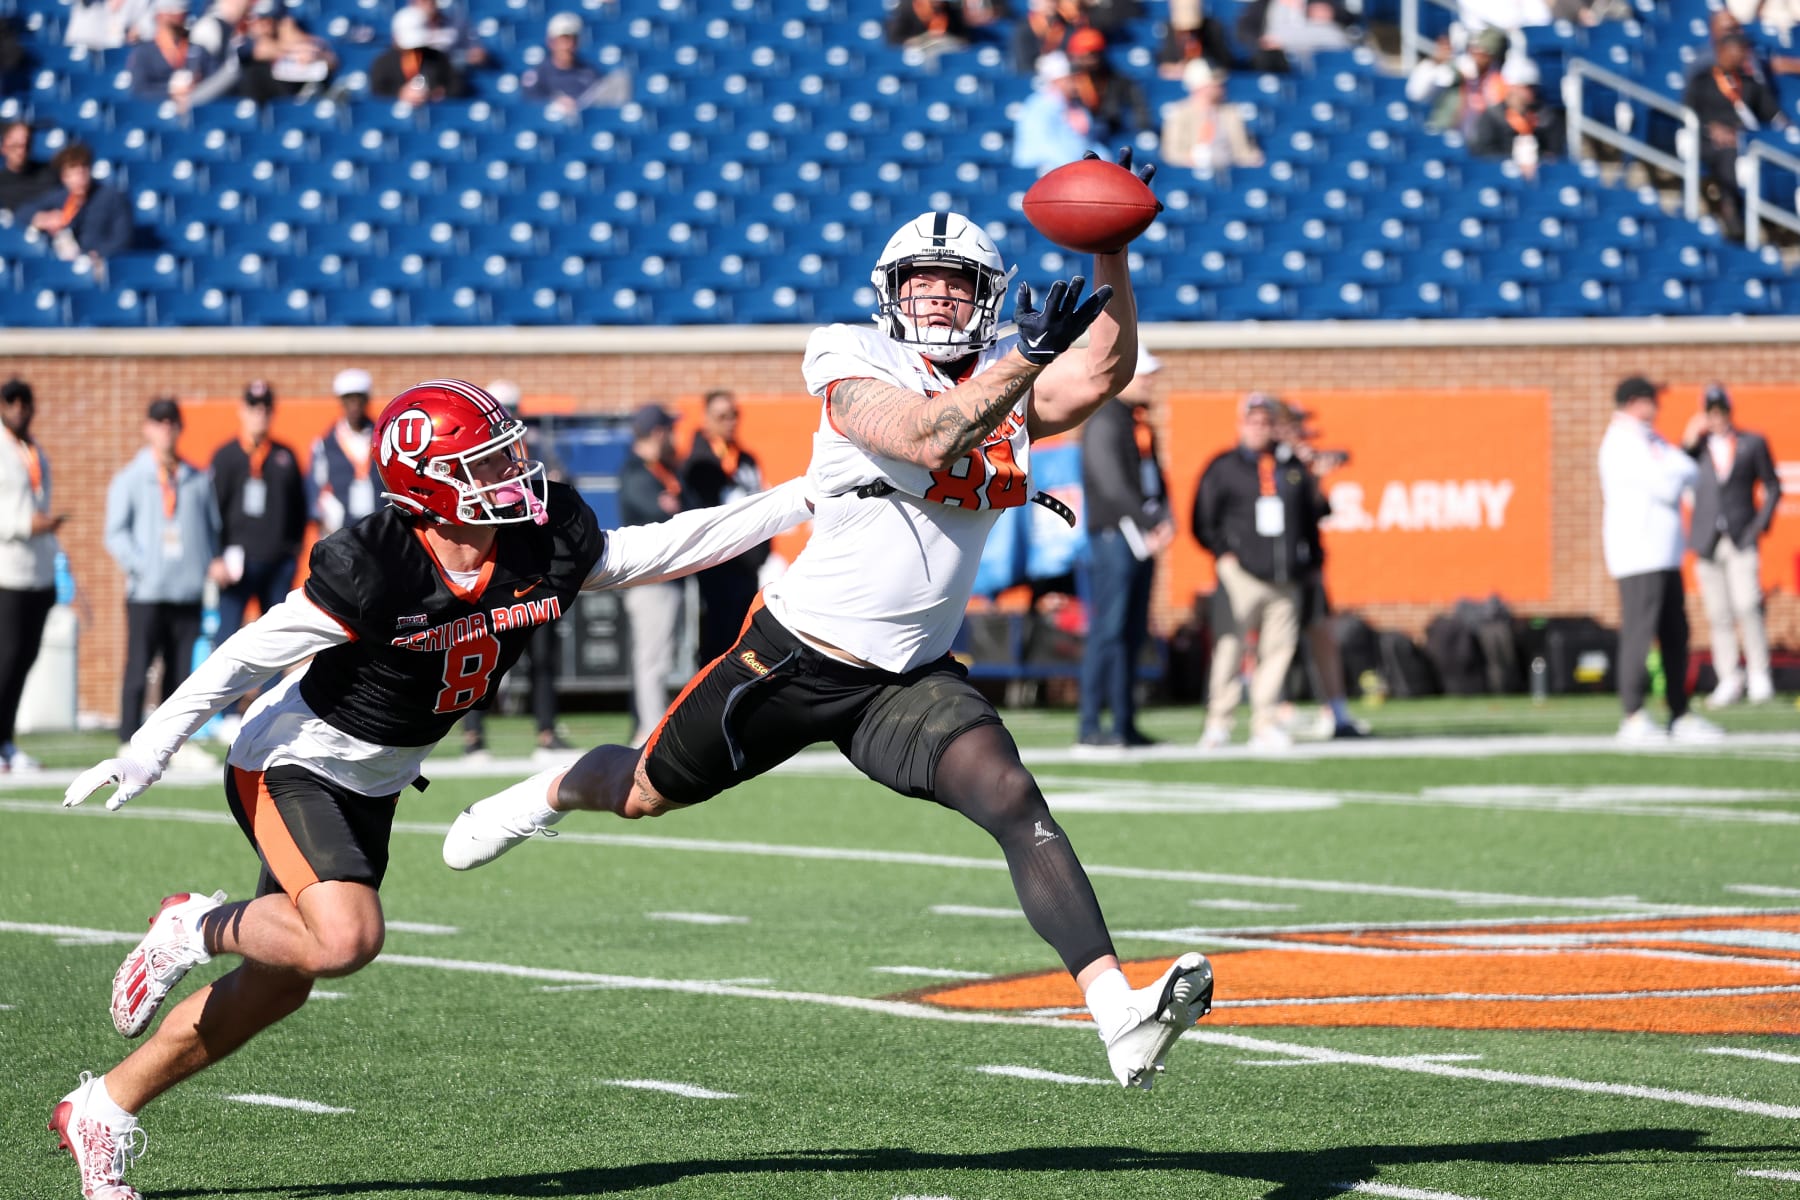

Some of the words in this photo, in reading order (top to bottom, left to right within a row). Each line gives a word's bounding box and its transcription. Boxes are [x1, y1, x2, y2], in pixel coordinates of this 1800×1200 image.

[398, 418, 425, 452] U
[924, 440, 1027, 511] 84
[1376, 479, 1514, 531] ARMY
[433, 633, 500, 714] 8
